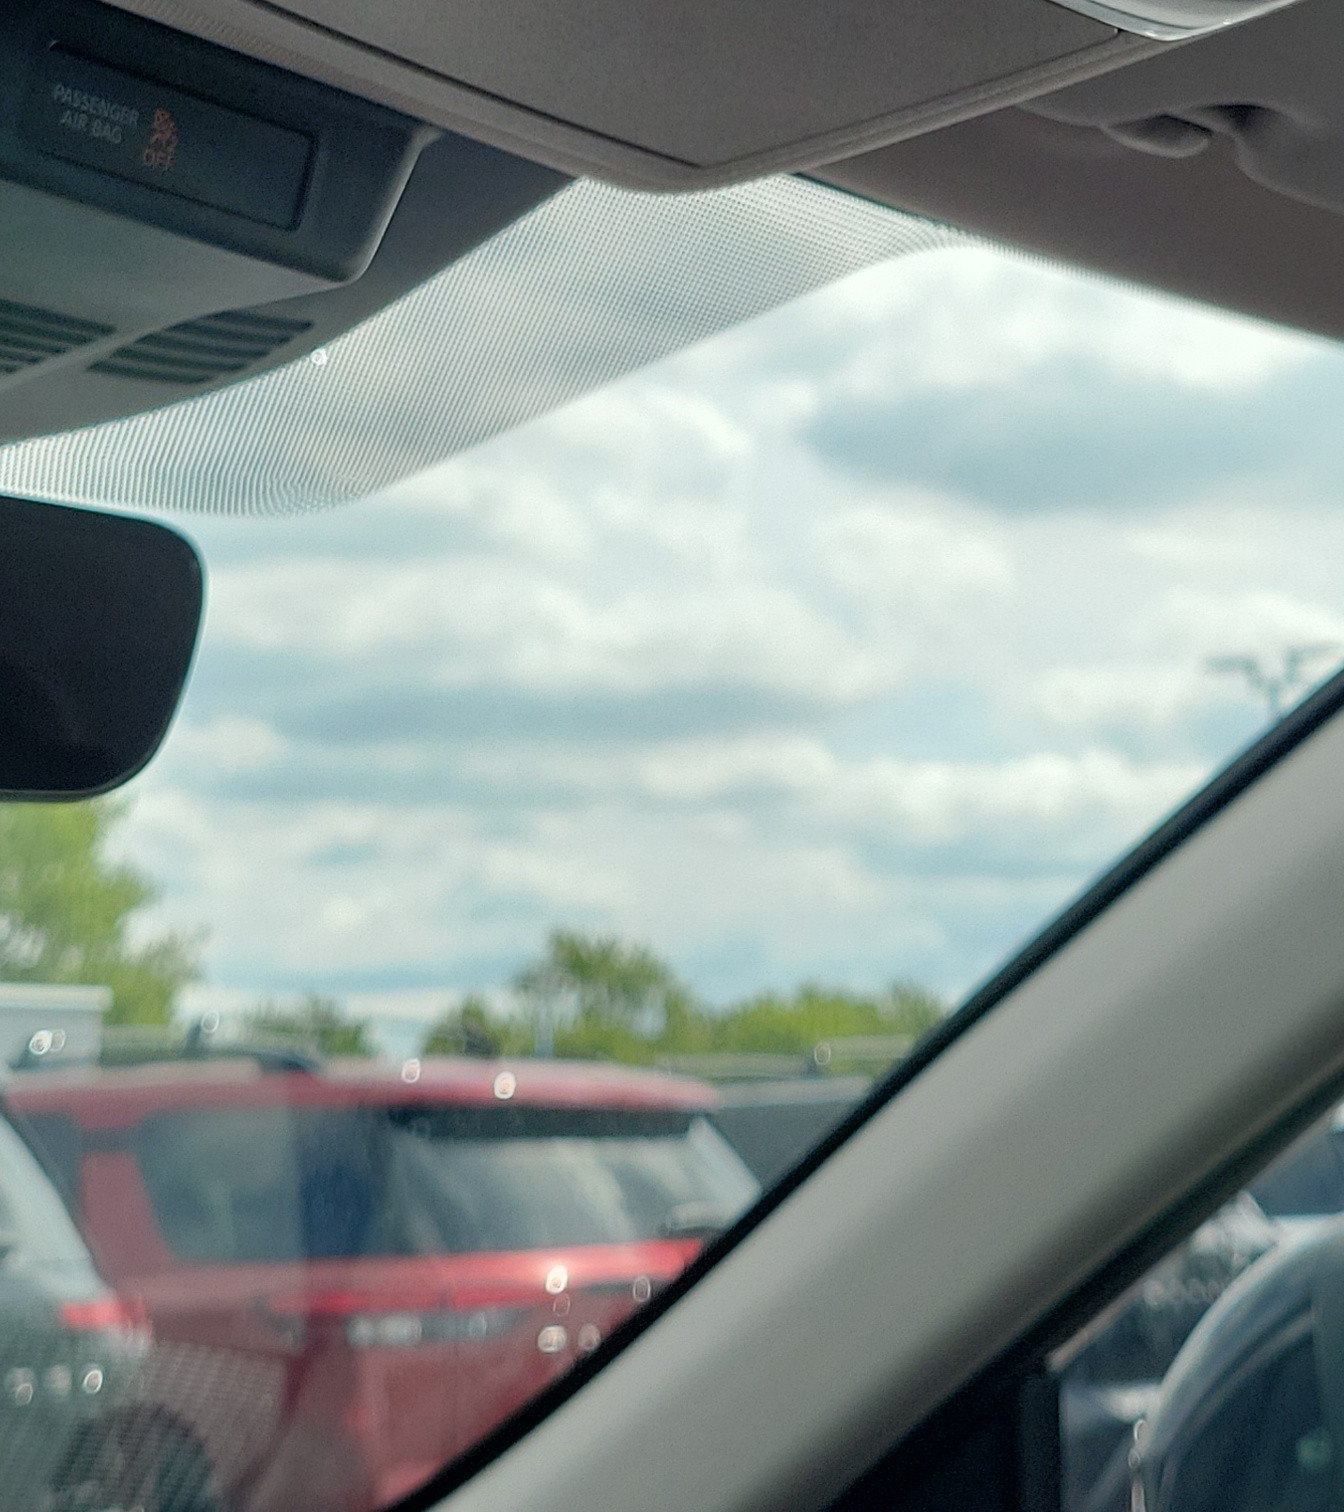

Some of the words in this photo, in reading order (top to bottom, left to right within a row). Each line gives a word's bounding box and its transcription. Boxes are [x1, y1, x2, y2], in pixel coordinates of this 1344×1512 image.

[52, 82, 141, 129] PASSENGER
[58, 109, 89, 133] AIR
[91, 119, 124, 145] BAG
